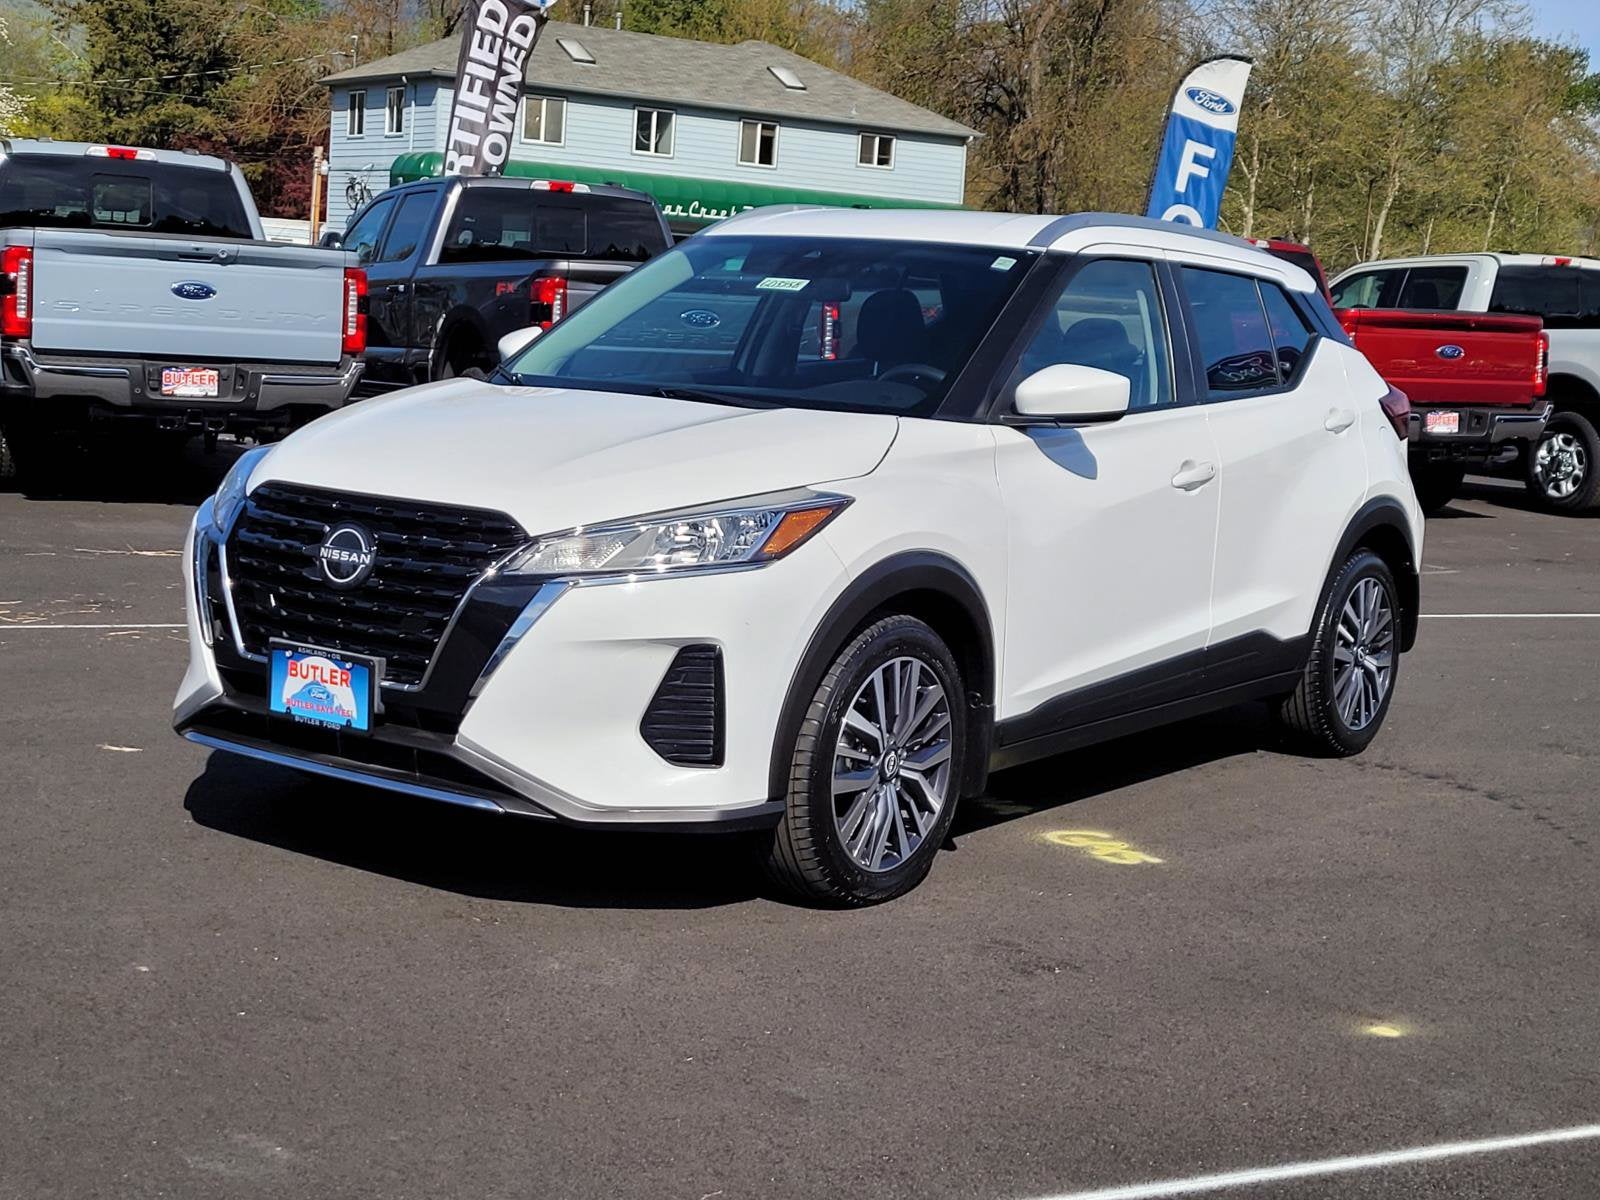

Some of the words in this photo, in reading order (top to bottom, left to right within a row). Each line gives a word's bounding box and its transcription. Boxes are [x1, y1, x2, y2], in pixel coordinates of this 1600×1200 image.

[1195, 90, 1228, 113] Ford
[164, 373, 216, 386] BUTLER
[320, 546, 371, 564] NISSAN
[288, 660, 351, 688] BUTLER
[310, 687, 328, 700] Ford
[286, 698, 314, 710] BUTLER
[315, 704, 335, 714] SAYS
[295, 715, 320, 726] BUTLER
[323, 721, 341, 730] FORD
